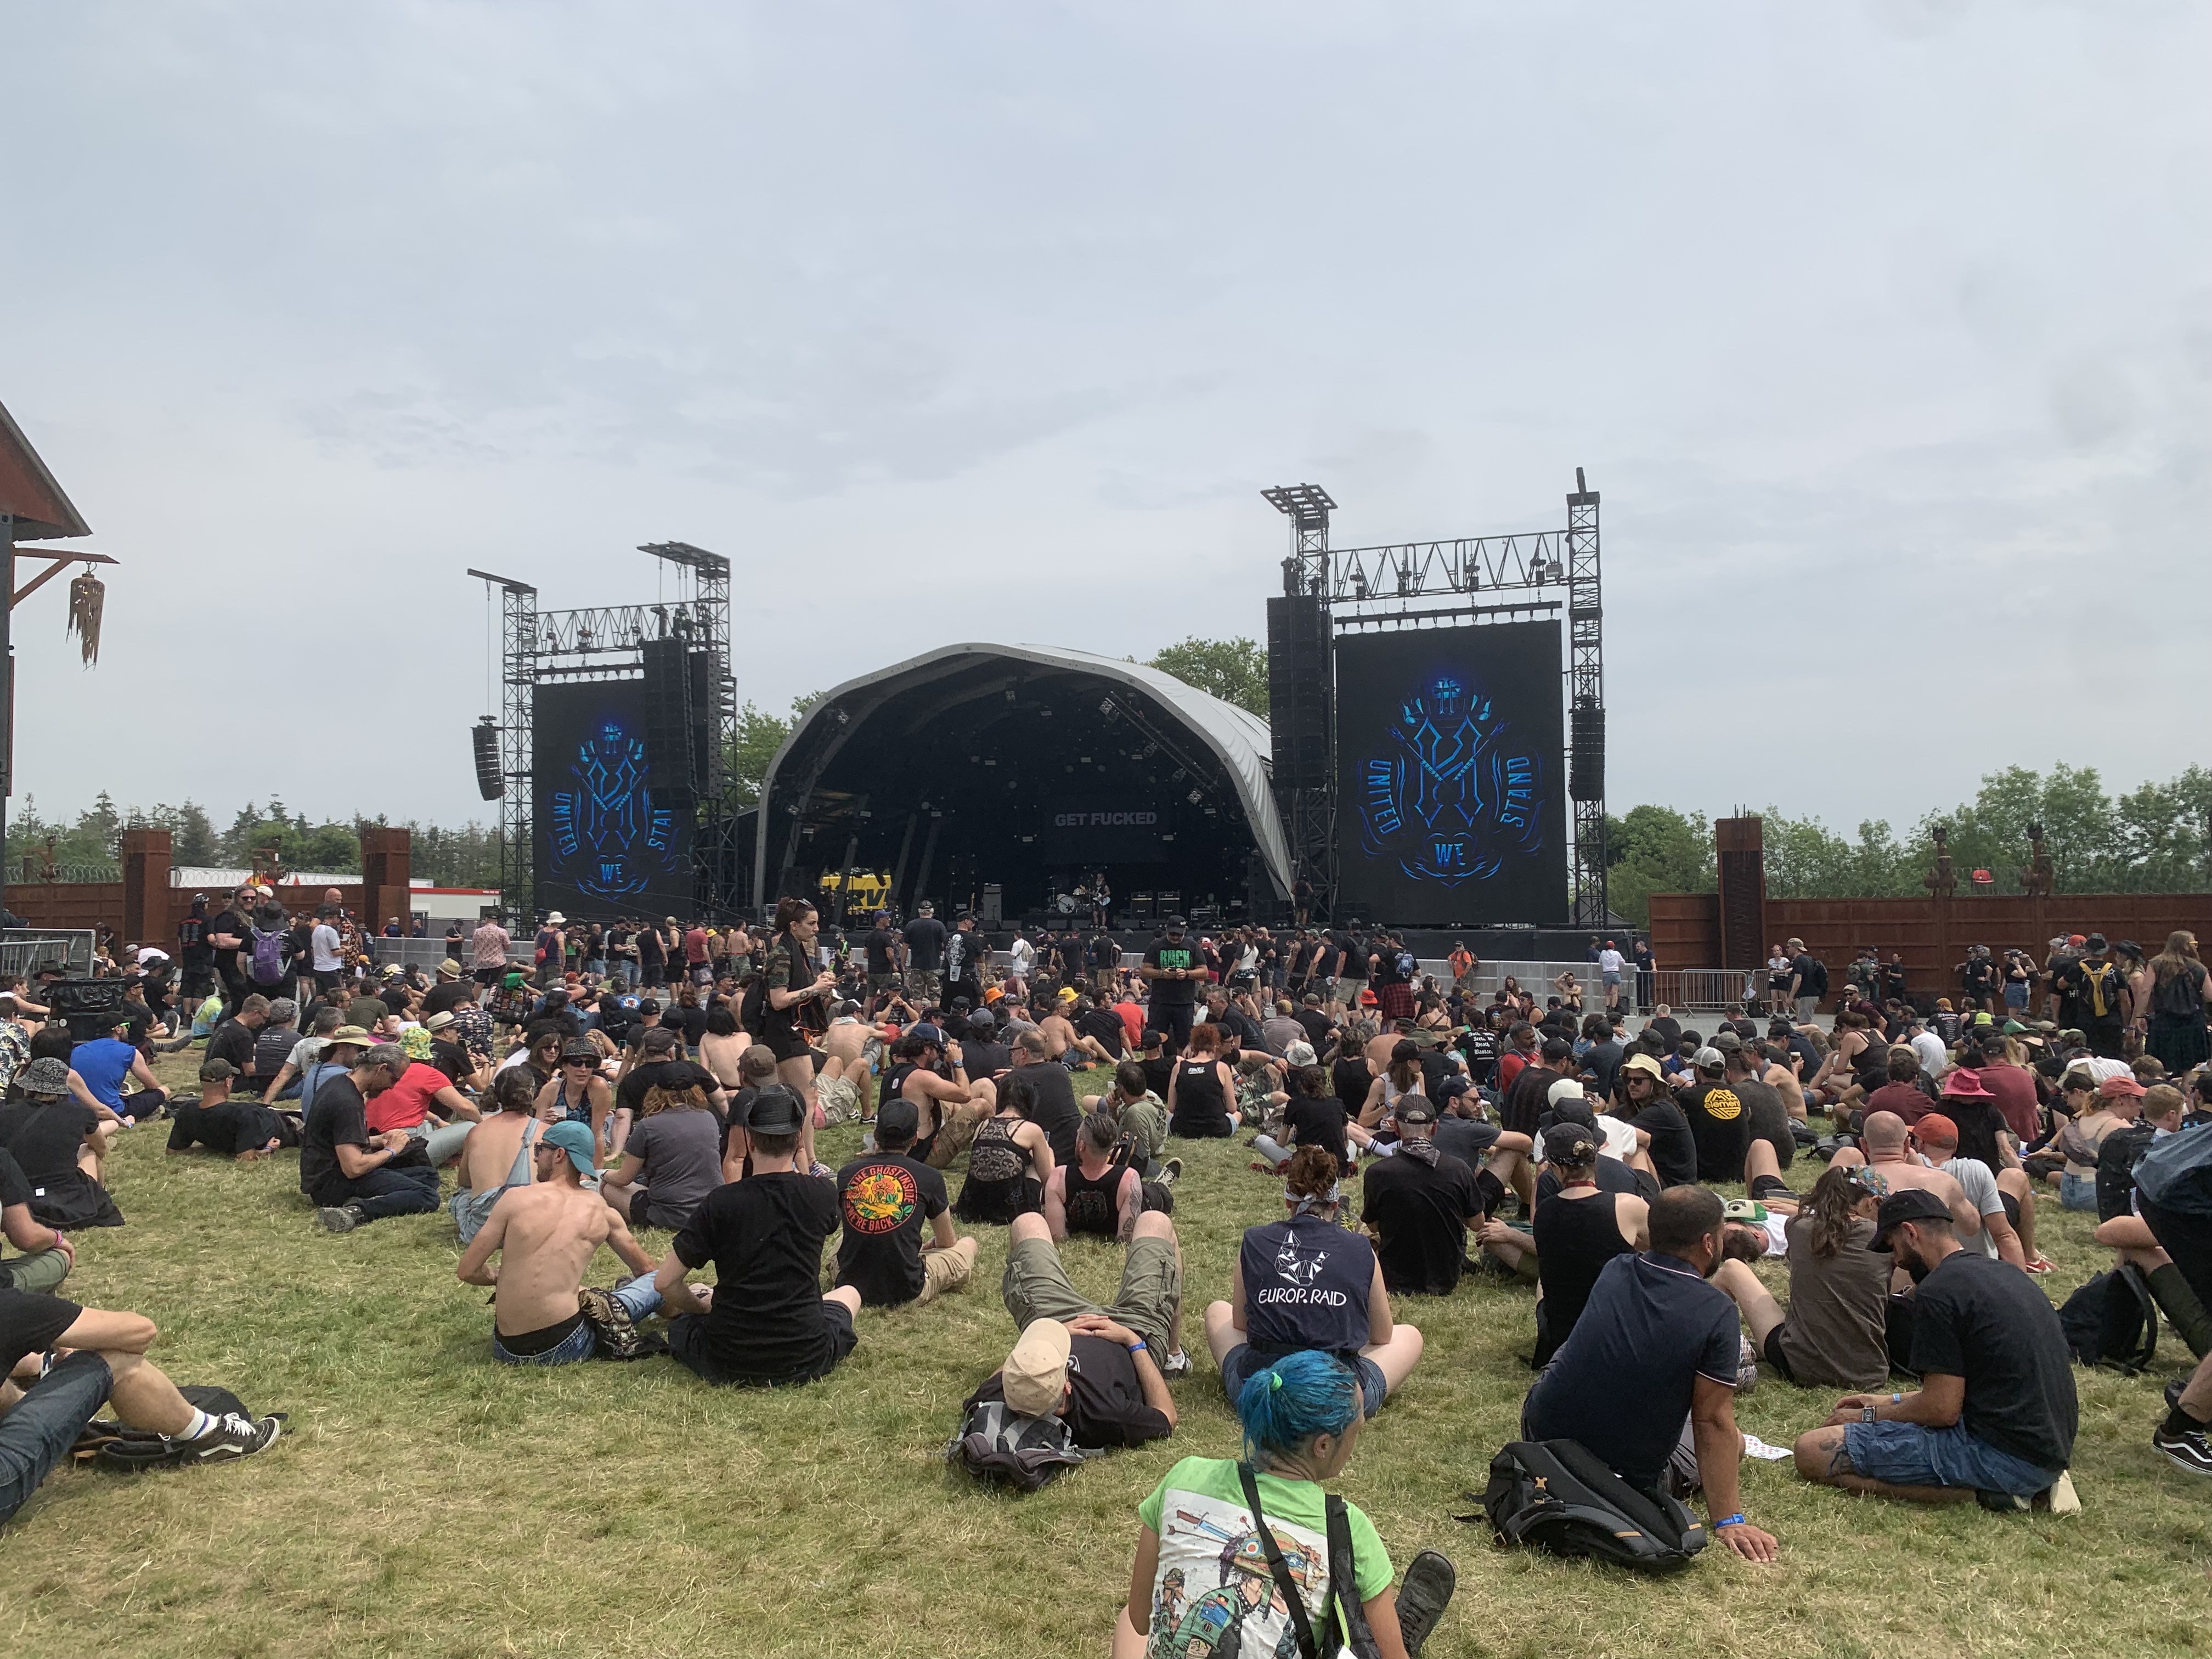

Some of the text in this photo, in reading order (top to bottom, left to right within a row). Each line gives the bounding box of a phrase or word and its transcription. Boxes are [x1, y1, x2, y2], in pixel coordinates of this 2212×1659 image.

[1055, 811, 1157, 826] GET FUCKED
[1367, 756, 1532, 867] UNITED WE STAND
[554, 792, 672, 884] UNITED WE STA
[1704, 1100, 1741, 1108] elemen
[851, 1167, 915, 1204] THE GHOST INSIDE
[848, 1206, 894, 1231] WE'RE BACK
